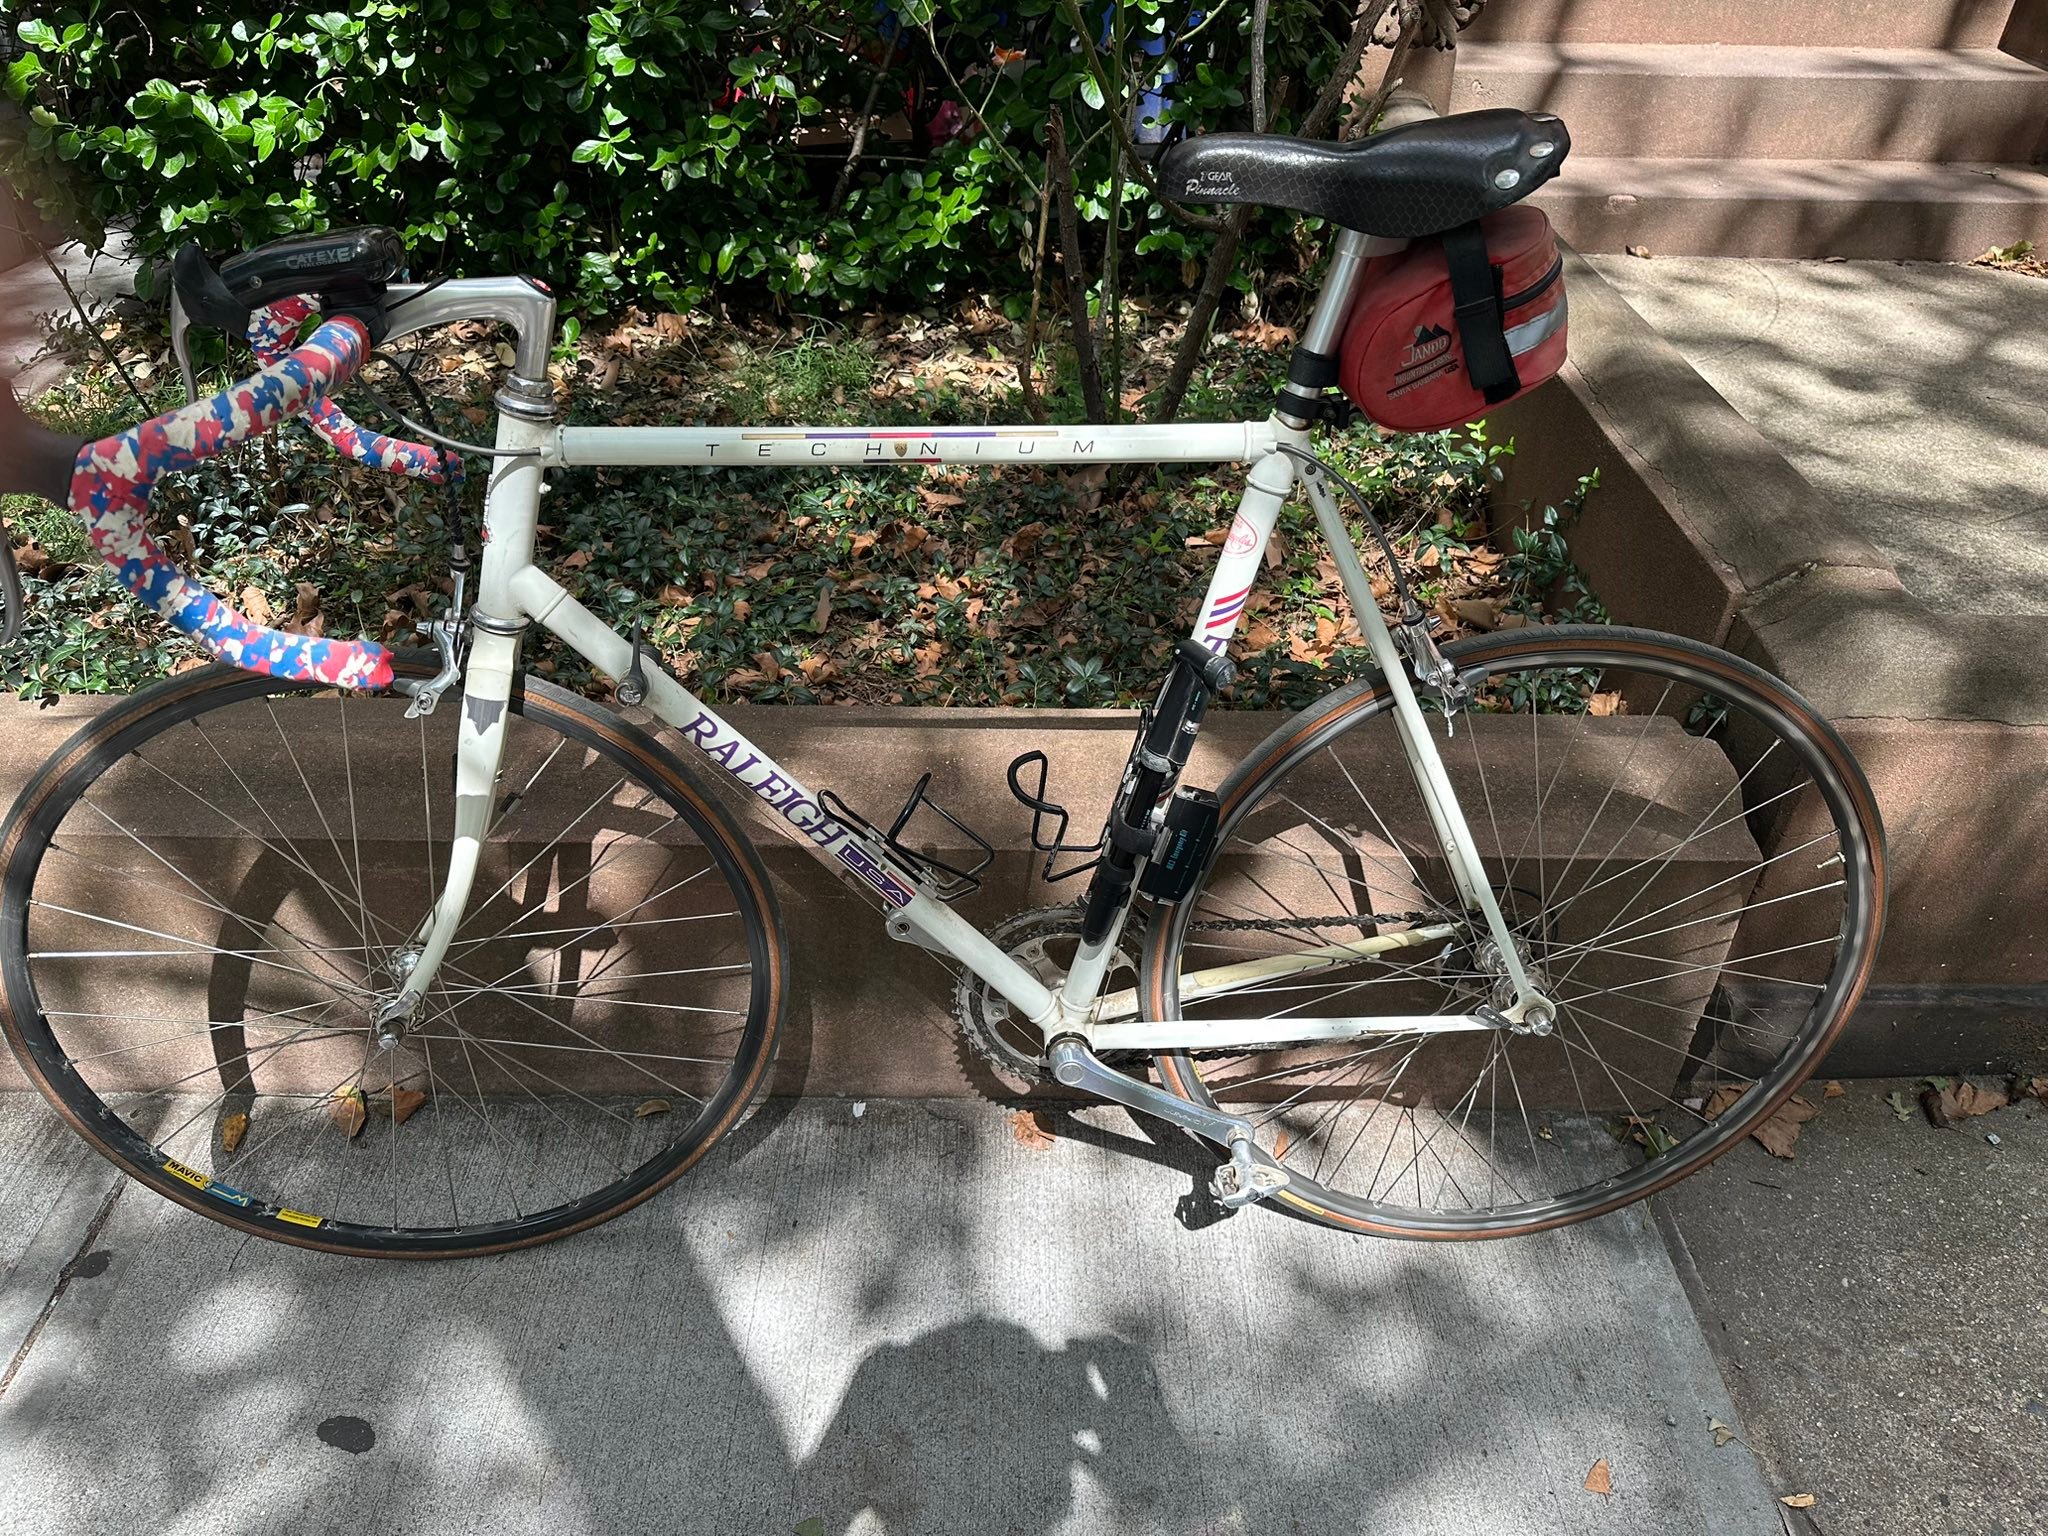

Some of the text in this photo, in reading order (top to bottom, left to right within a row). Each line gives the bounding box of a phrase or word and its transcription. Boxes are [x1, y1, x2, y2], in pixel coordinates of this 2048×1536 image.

[1185, 178, 1240, 196] Pinnacle
[705, 441, 1096, 456] TECHNIUM
[675, 712, 905, 905] RALEIGH USA
[168, 1161, 203, 1183] MAVIC
